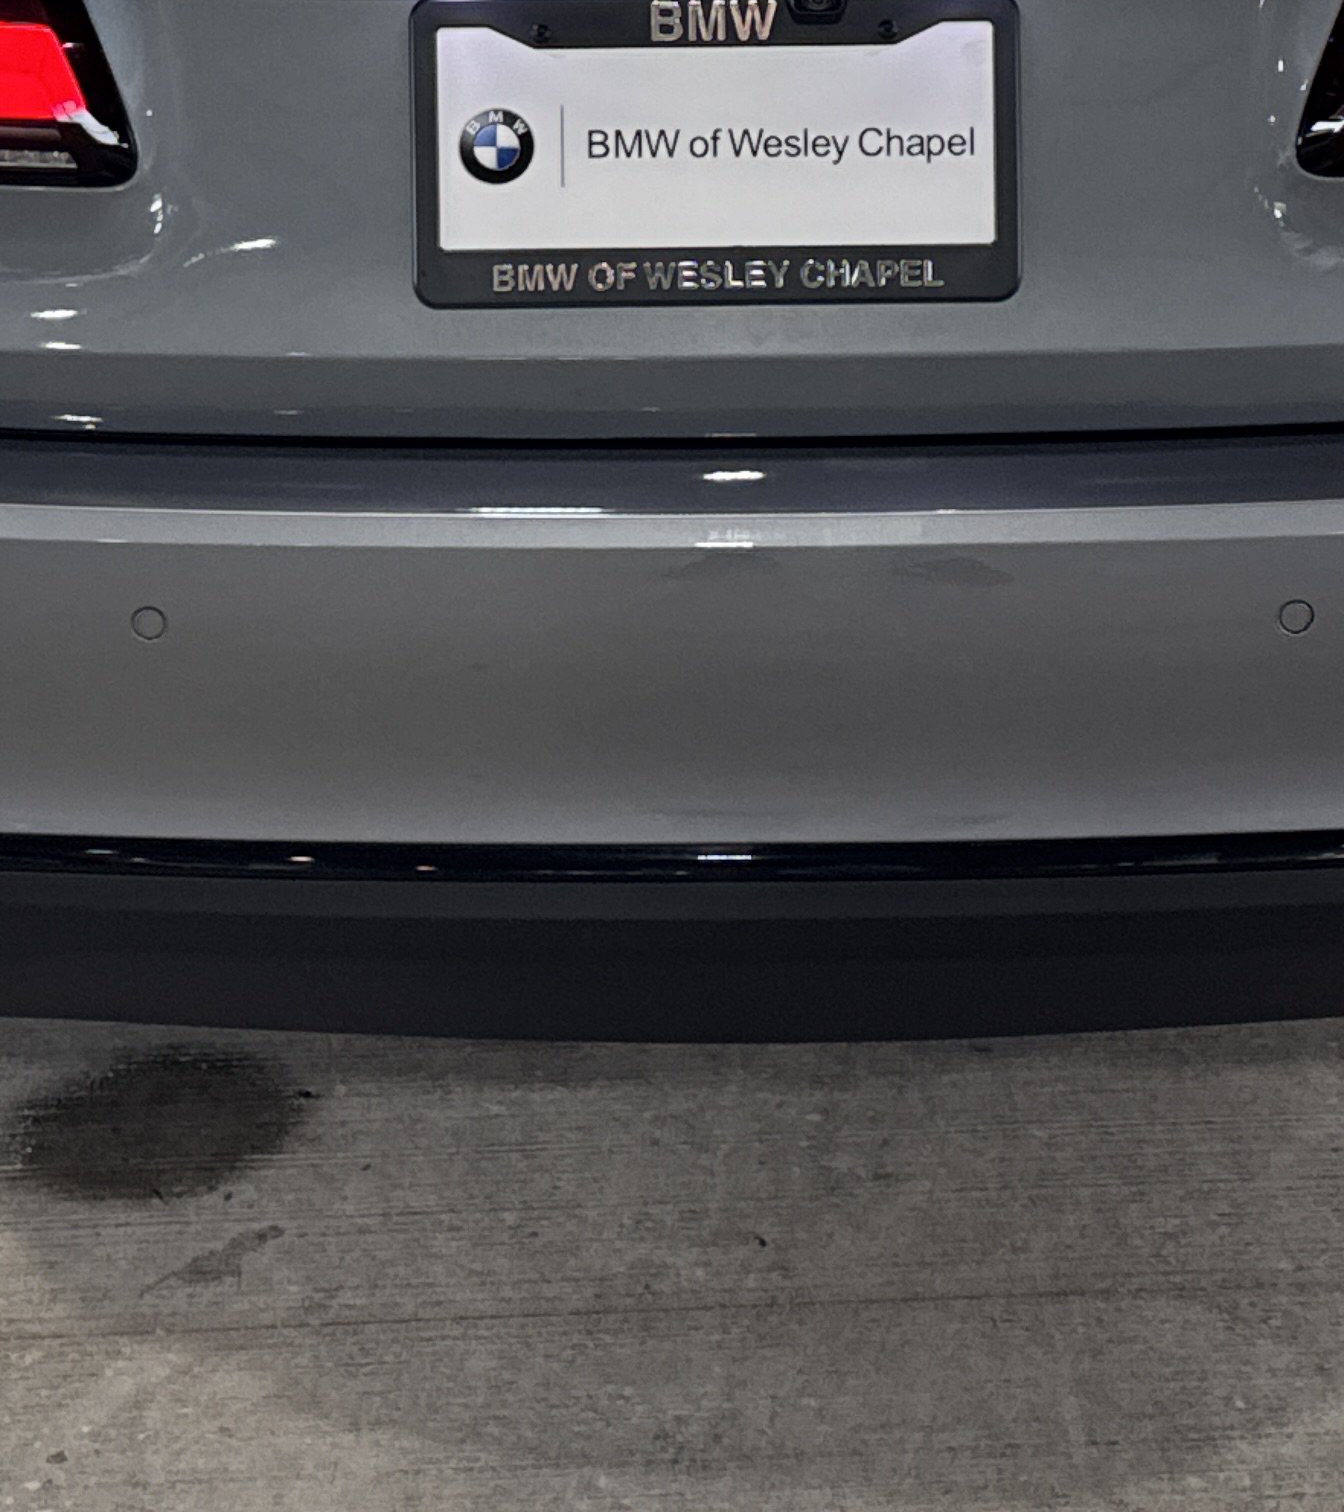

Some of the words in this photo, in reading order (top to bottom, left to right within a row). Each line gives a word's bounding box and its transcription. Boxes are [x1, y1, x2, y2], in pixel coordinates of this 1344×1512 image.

[650, 0, 777, 42] BMW
[466, 110, 527, 136] BMW
[588, 129, 680, 158] BMW
[690, 128, 722, 158] of
[728, 128, 850, 165] Wesley
[858, 126, 976, 163] Chapel
[492, 262, 577, 292] BMW
[588, 261, 636, 291] OF
[644, 259, 788, 289] WESLEY
[799, 257, 944, 287] CHAPEL
